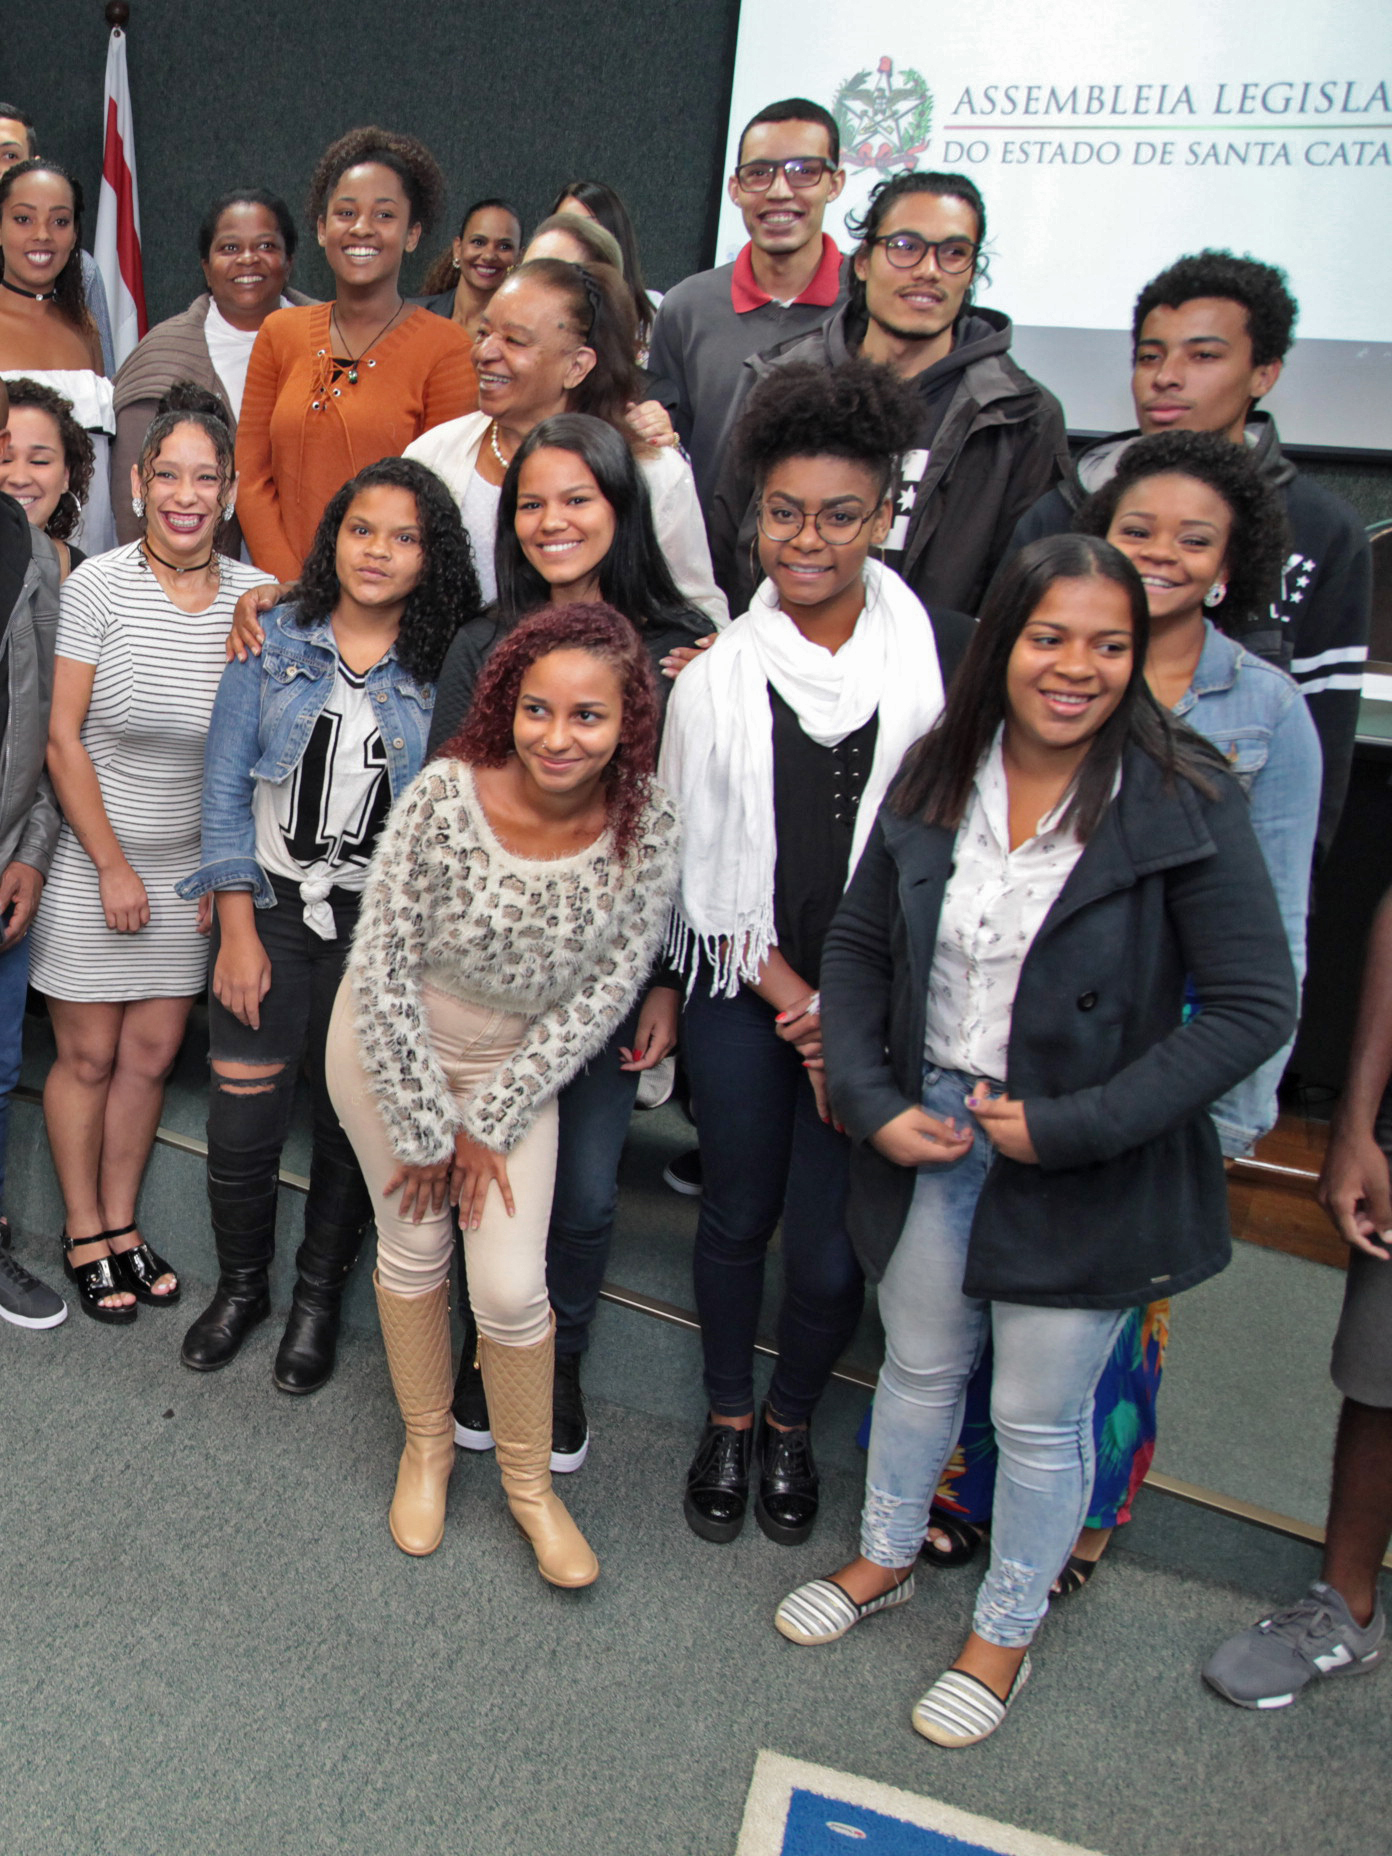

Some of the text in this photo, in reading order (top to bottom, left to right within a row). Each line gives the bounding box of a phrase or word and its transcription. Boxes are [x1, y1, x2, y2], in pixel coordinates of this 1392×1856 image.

[952, 80, 1392, 115] ASSEMBLEIA LEGISLA
[942, 140, 1392, 166] DO ESTADO DE SANTA CATA
[1313, 1644, 1352, 1672] N
